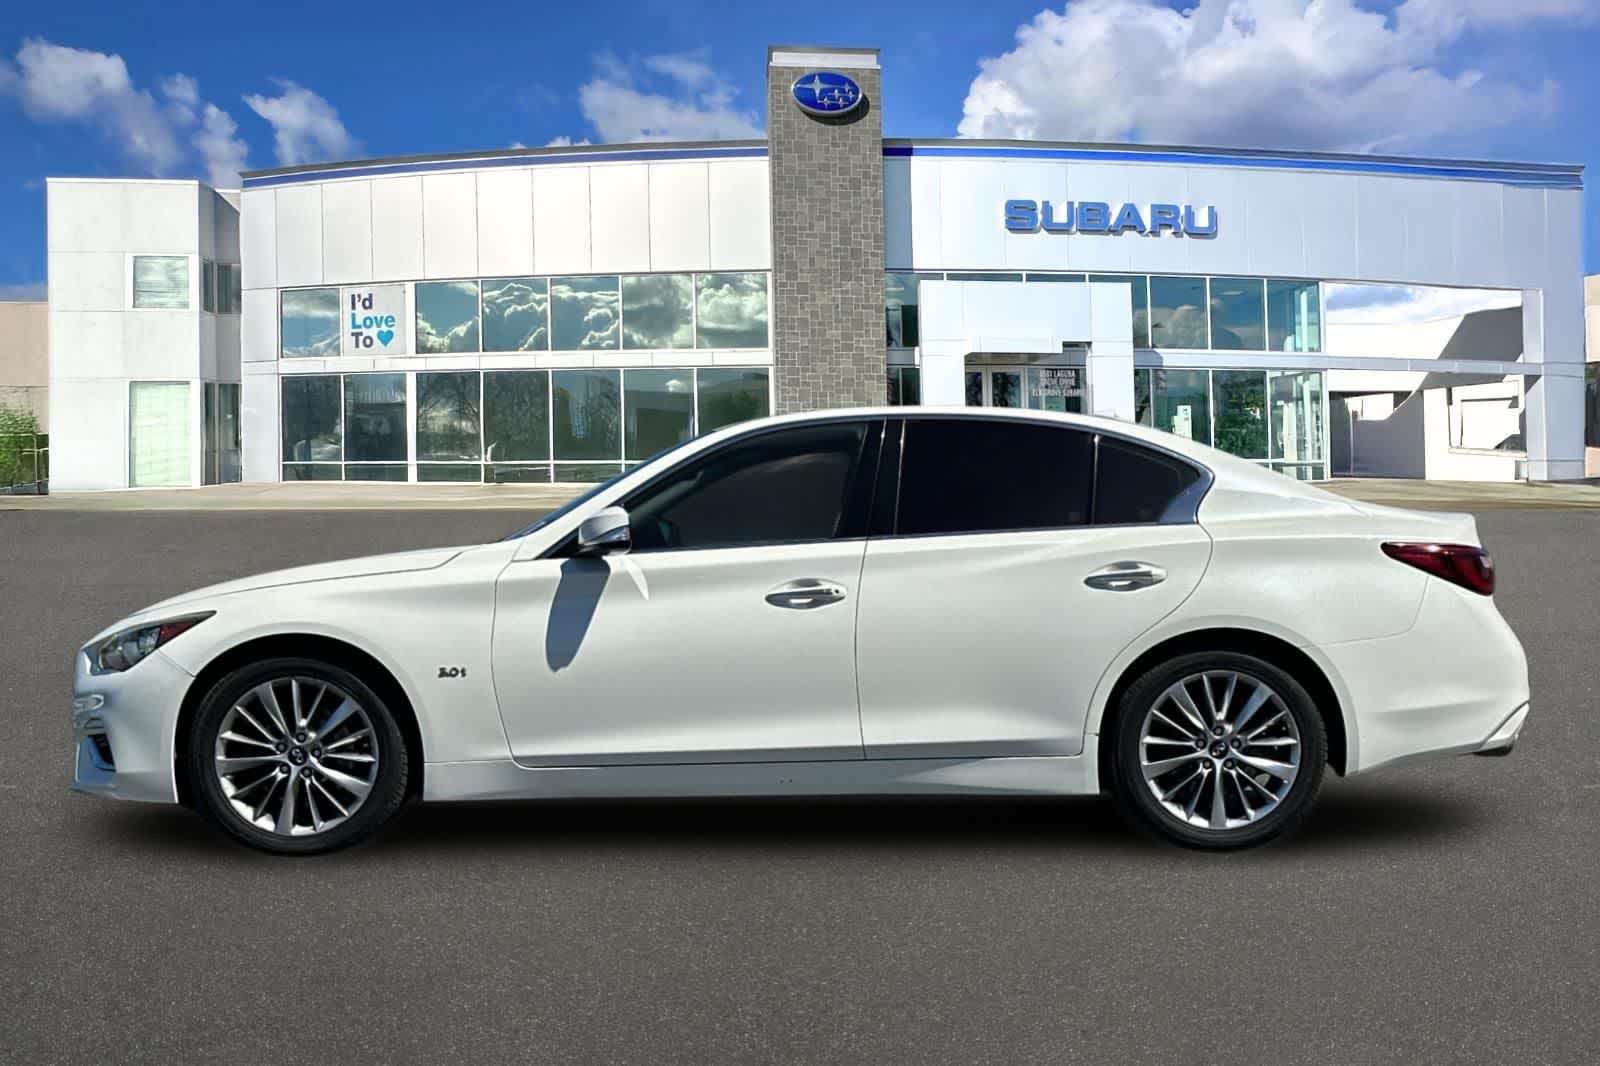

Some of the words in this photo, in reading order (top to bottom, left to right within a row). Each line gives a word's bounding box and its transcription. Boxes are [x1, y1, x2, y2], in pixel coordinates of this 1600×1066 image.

[1005, 199, 1217, 238] SUBARU
[351, 293, 373, 310] I'd
[351, 312, 396, 329] Love
[351, 331, 374, 348] To
